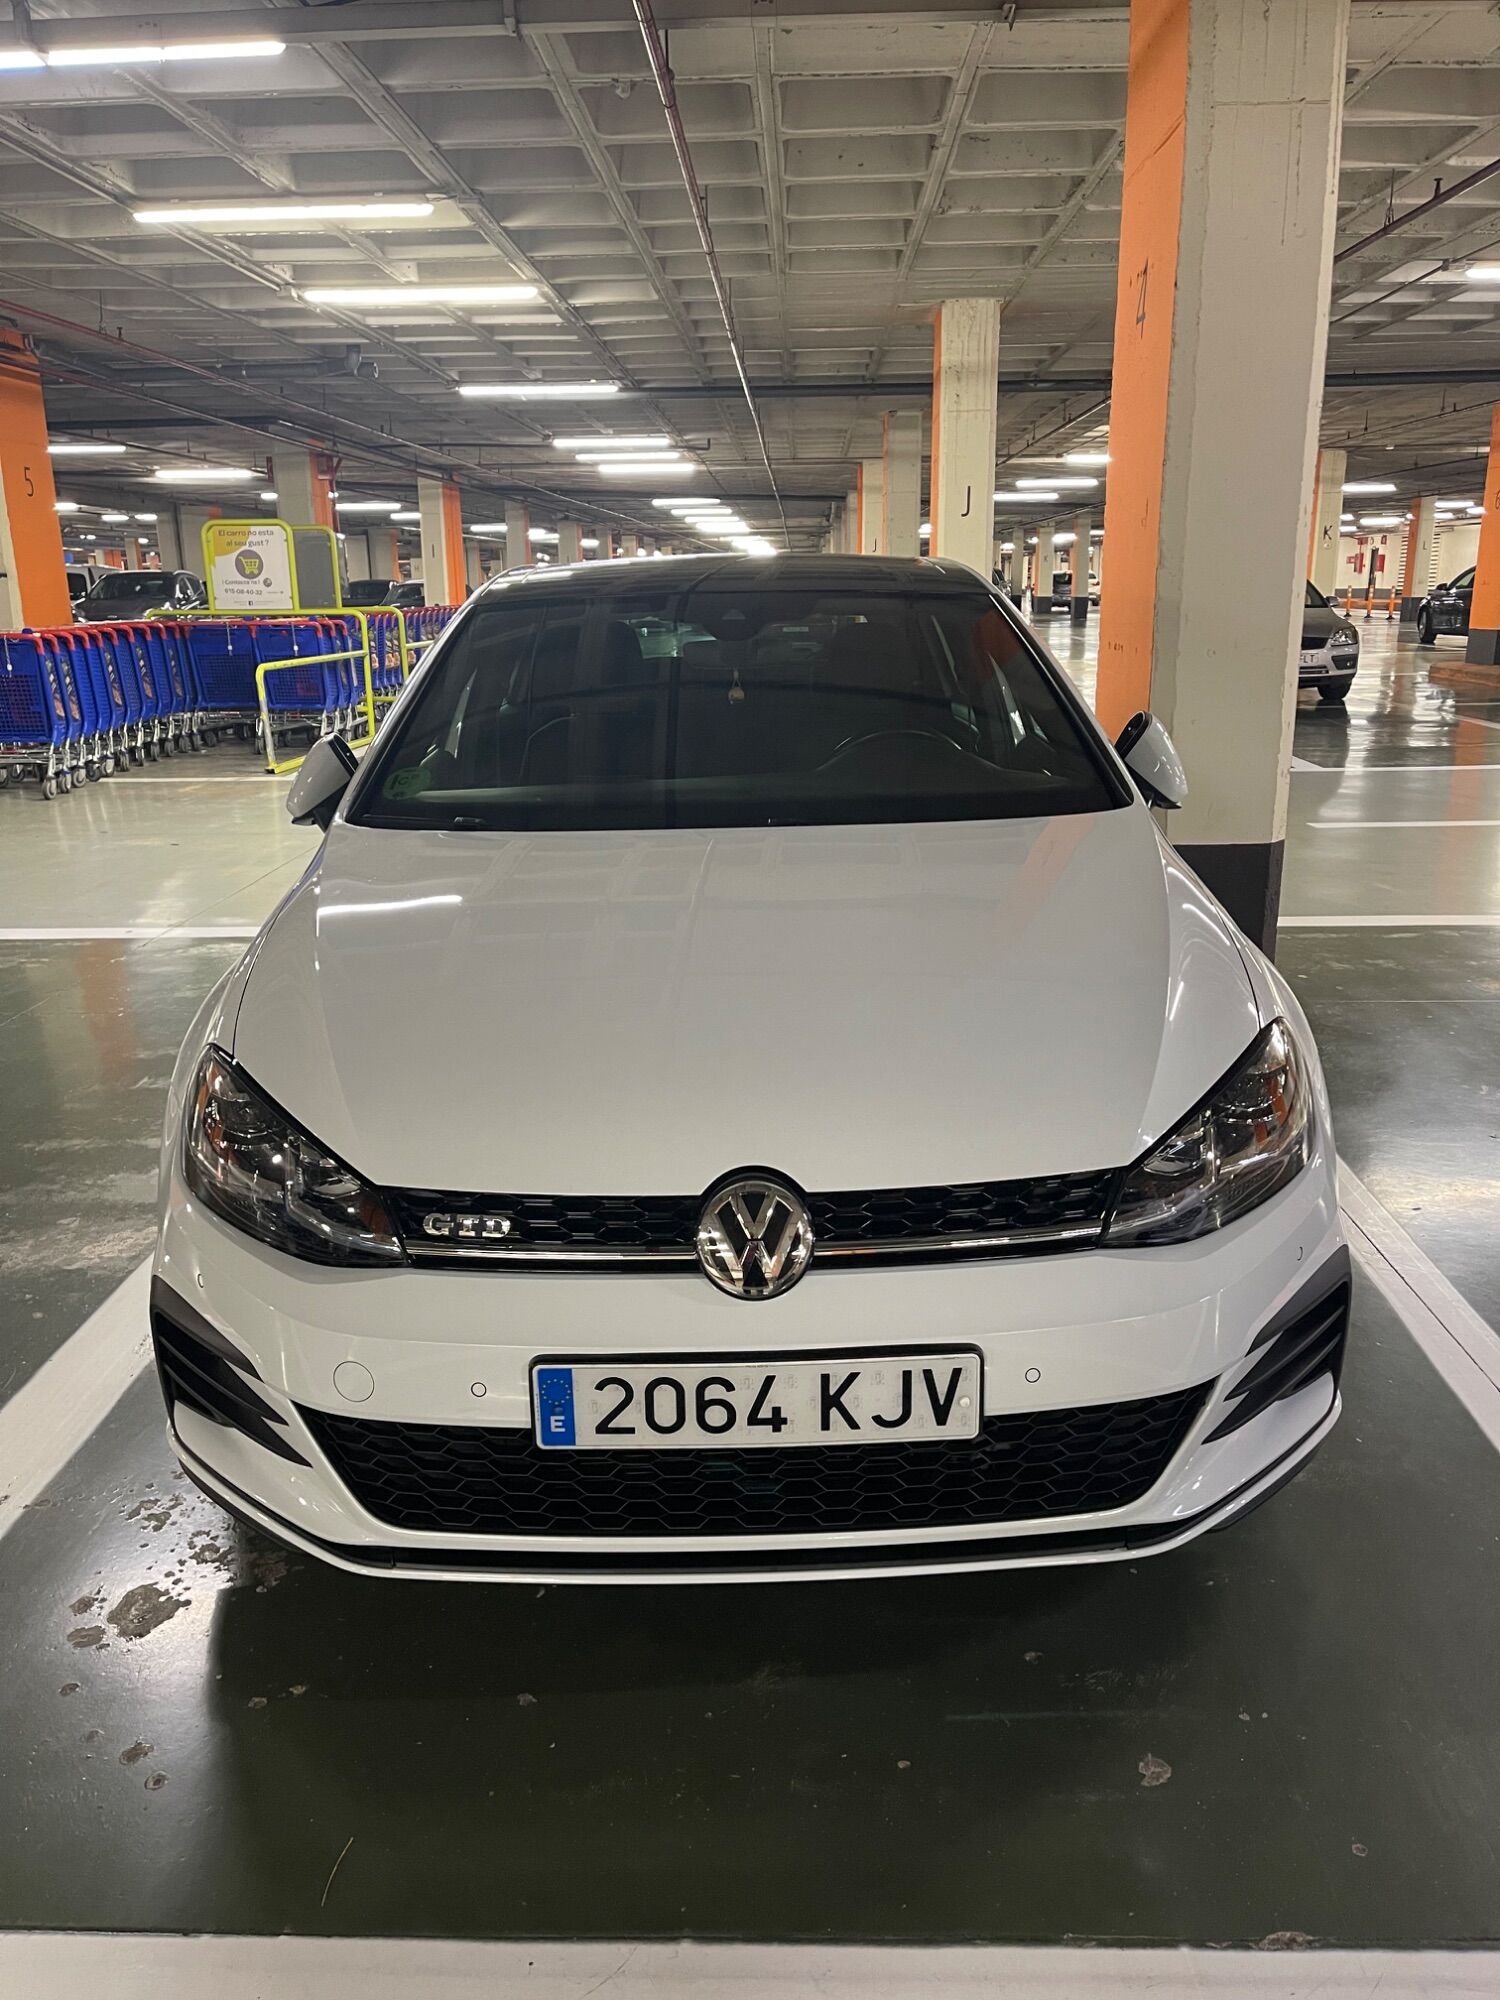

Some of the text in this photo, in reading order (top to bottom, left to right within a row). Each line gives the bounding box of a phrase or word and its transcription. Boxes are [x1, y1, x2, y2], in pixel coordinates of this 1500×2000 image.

[23, 466, 35, 497] 5
[961, 485, 971, 517] J
[248, 540, 264, 548] gust
[872, 537, 877, 553] J
[1323, 525, 1333, 541] K
[421, 1212, 512, 1238] GTD
[549, 1415, 566, 1433] E
[592, 1373, 789, 1436] 2064
[819, 1366, 964, 1432] KJV
